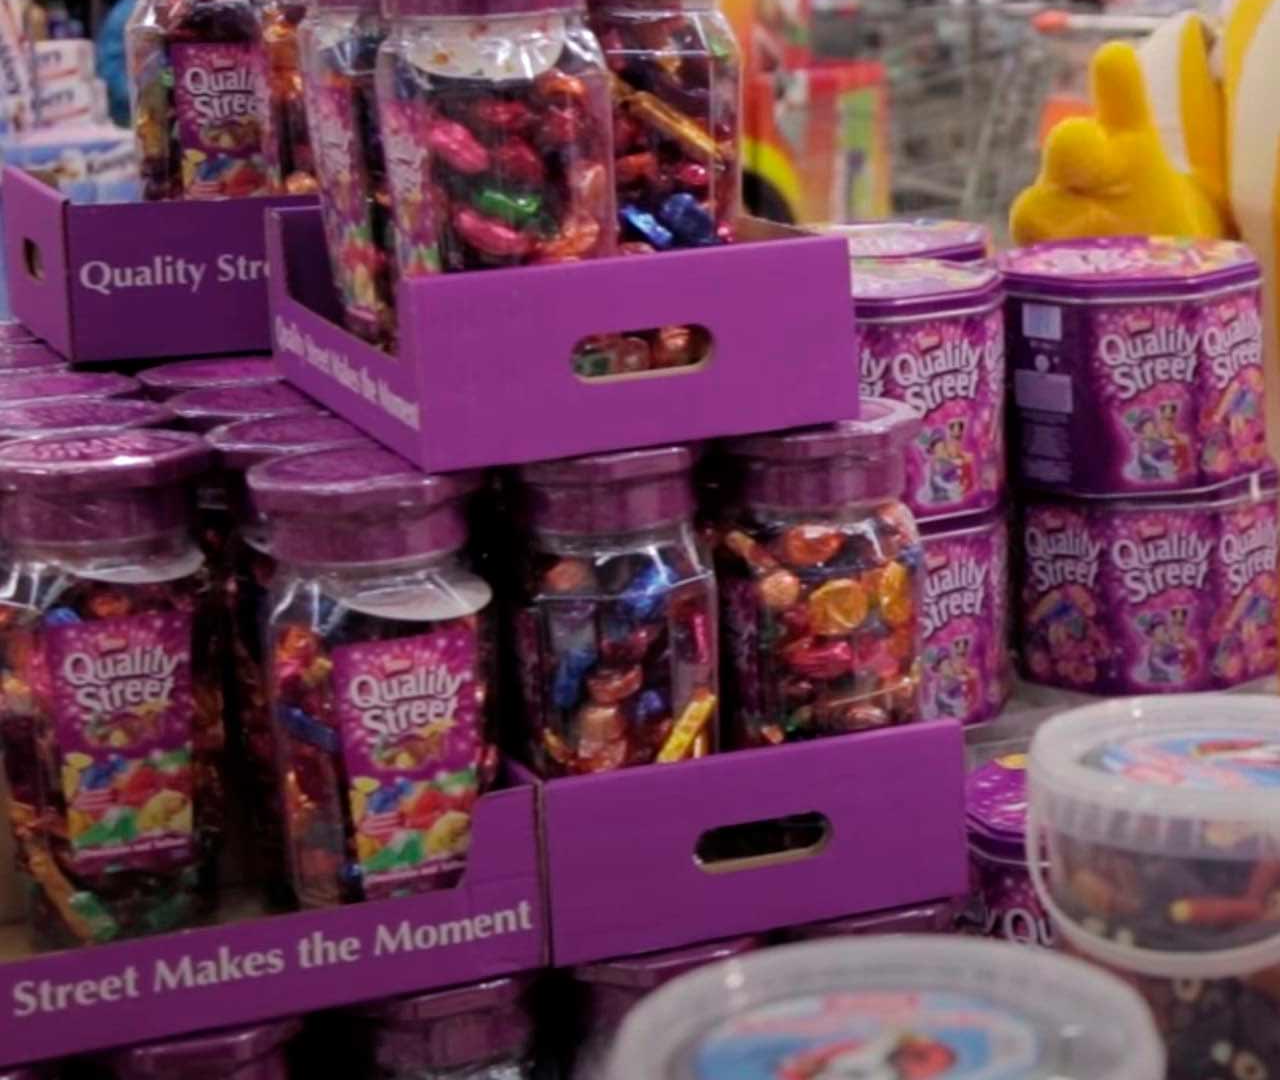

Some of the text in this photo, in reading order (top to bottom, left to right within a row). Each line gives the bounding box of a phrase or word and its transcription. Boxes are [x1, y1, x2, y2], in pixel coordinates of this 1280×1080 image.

[193, 92, 265, 124] Stree
[79, 255, 206, 295] Quality
[893, 338, 981, 386] Quality
[1100, 325, 1200, 366] Quality
[905, 369, 979, 416] Street
[1113, 353, 1197, 401] Street
[1025, 526, 1101, 561] Quality
[1111, 531, 1214, 570] Quality
[924, 557, 989, 598] uality
[1031, 559, 1100, 593] Street
[1123, 562, 1209, 604] Street
[63, 645, 180, 687] Quality
[75, 675, 175, 715] Street
[350, 666, 464, 709] Quality
[362, 697, 459, 738] Street
[11, 899, 533, 1018] Street Makes the Moment
